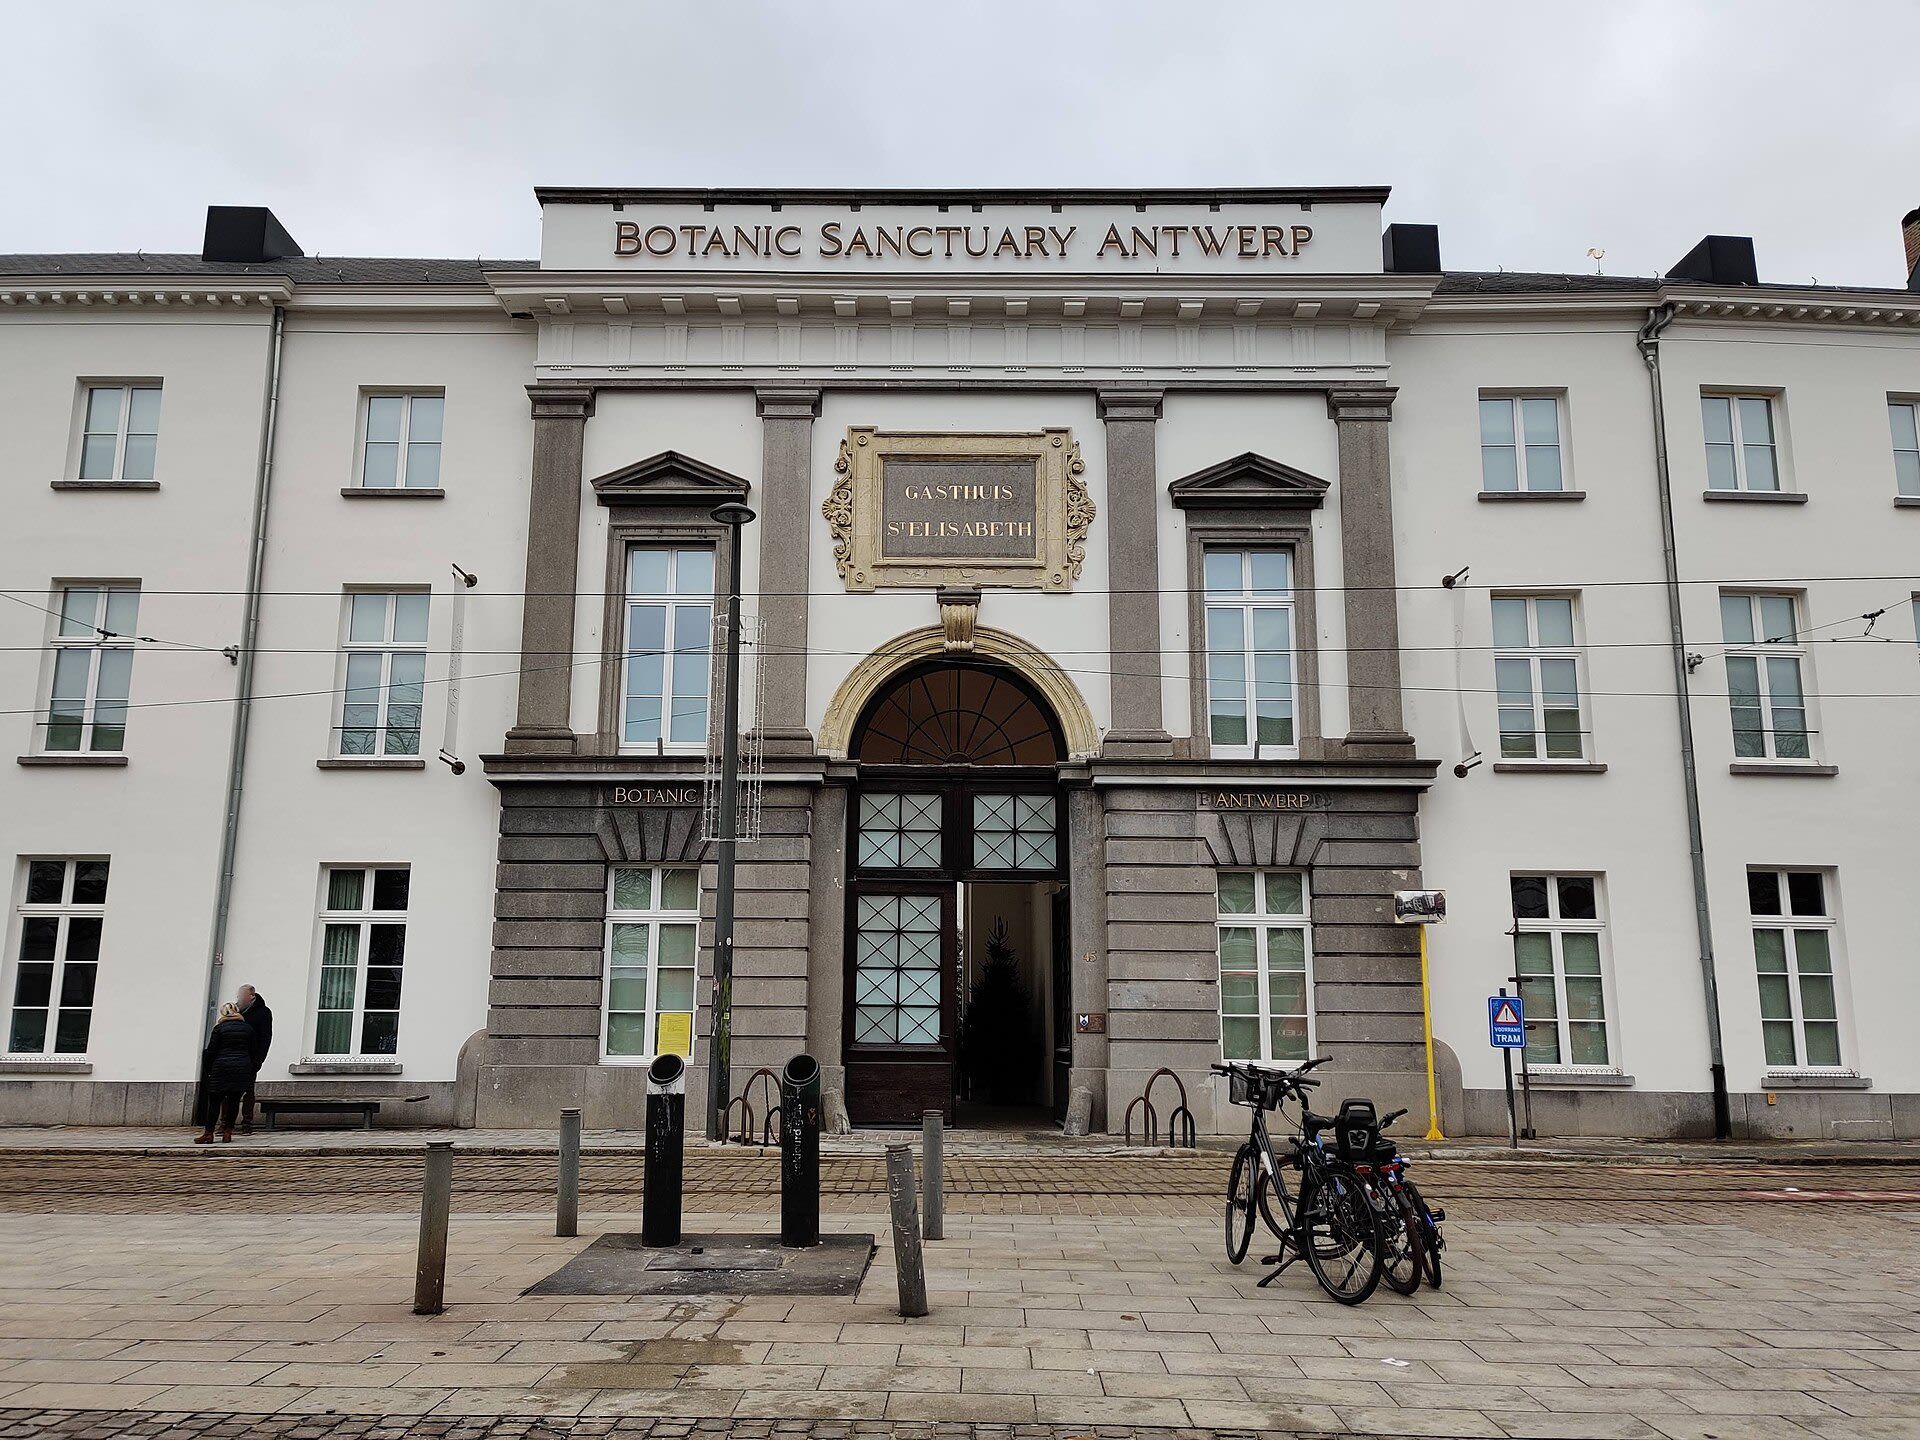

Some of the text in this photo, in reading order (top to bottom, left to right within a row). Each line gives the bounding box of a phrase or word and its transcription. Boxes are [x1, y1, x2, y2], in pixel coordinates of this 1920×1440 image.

[613, 221, 1314, 258] BOTANIC SANCTUARY ANTWERP
[905, 485, 1013, 500] GASTHUIS
[614, 787, 698, 803] BOTANIC
[1214, 792, 1310, 808] ANTWERP
[1082, 951, 1097, 962] 45
[1495, 1034, 1521, 1043] TRAM
